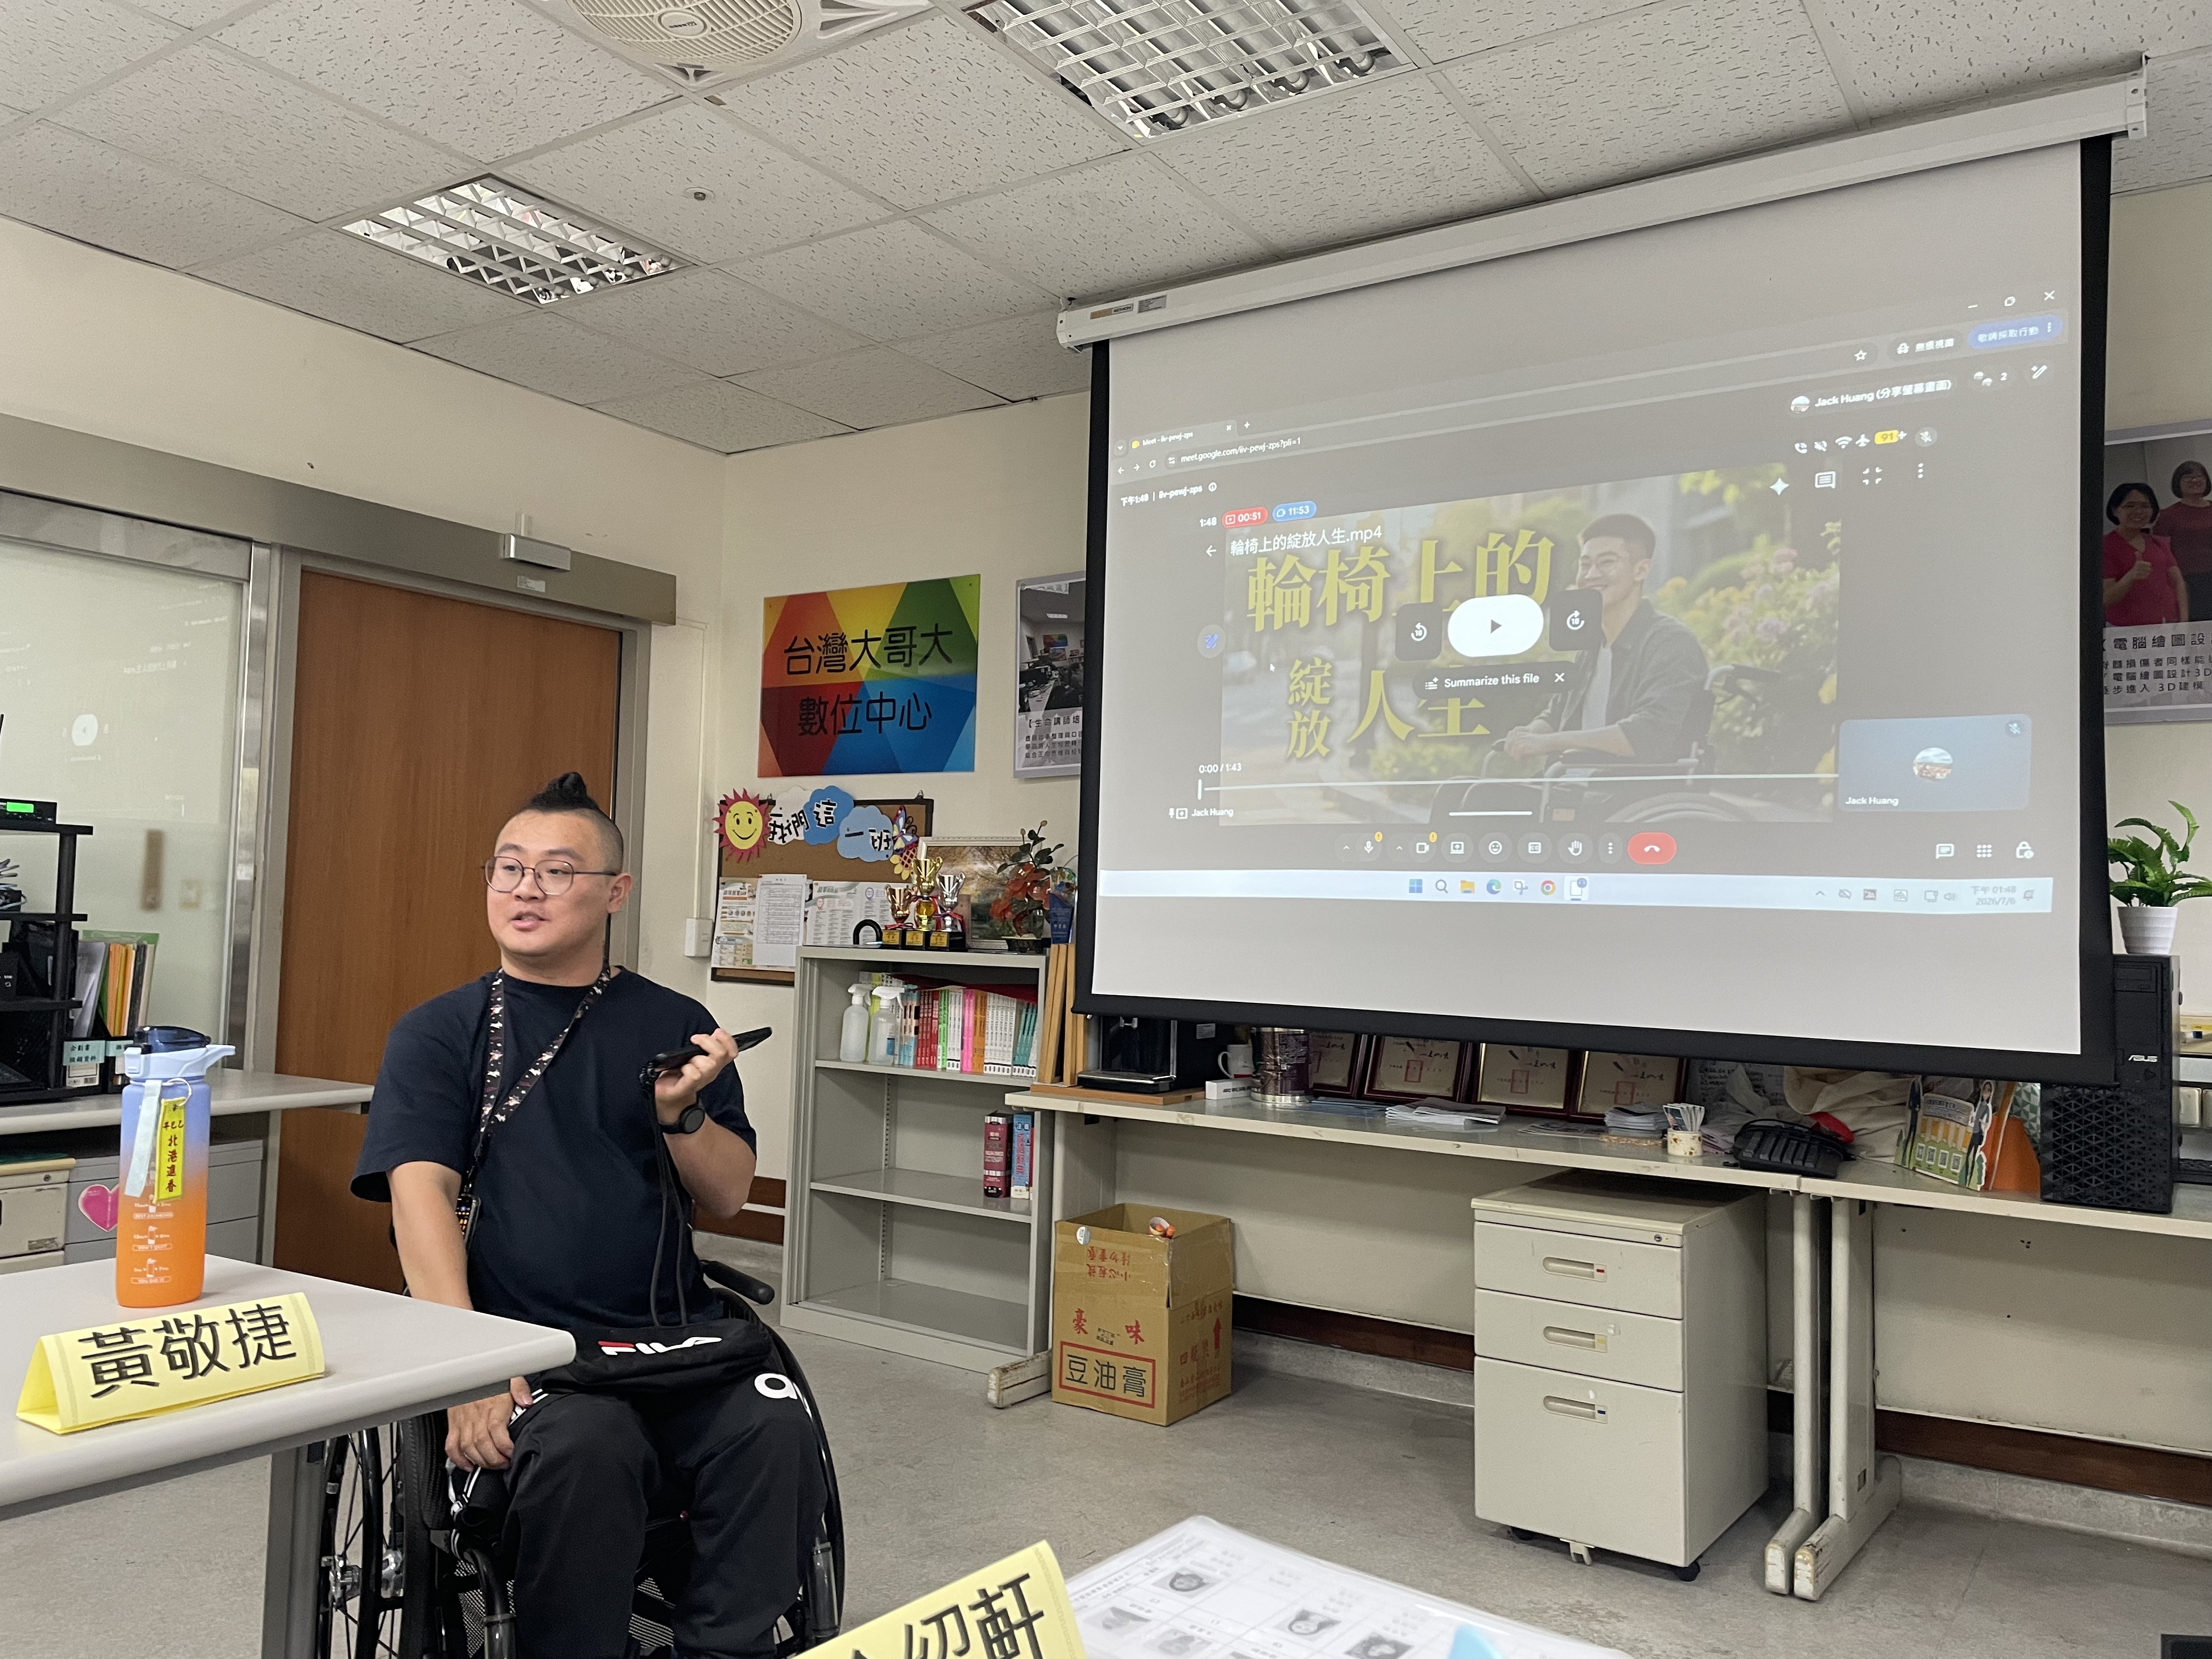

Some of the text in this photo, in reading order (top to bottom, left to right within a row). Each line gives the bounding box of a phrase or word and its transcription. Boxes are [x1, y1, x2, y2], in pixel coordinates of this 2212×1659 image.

[2000, 372, 2007, 381] 2
[1815, 396, 1839, 408] Jack
[1841, 392, 1875, 404] Huang
[1142, 438, 1156, 447] Meet
[1881, 432, 1894, 443] 91
[1238, 511, 1261, 523] 00:51
[1288, 505, 1310, 516] 11:53
[1199, 516, 1217, 527] 1:48
[1230, 525, 1383, 556] 輪椅上的綻放人生.mp4
[1246, 529, 1555, 632] 輪椅上的
[784, 623, 953, 676] 台灣大哥大
[1444, 673, 1540, 688] Summarize this file
[798, 691, 933, 737] 數位中心
[1286, 657, 1333, 759] 綻放
[1198, 764, 1219, 774] 0:00
[1225, 763, 1242, 772] 1:43
[1845, 795, 1899, 807] Jack Huang
[1191, 807, 1234, 817] Jack Huang
[2128, 1054, 2158, 1063] ASUS
[78, 1303, 297, 1398] 黃敬捷
[597, 1336, 723, 1356] FILA
[1065, 1353, 1147, 1398] 豆油膏
